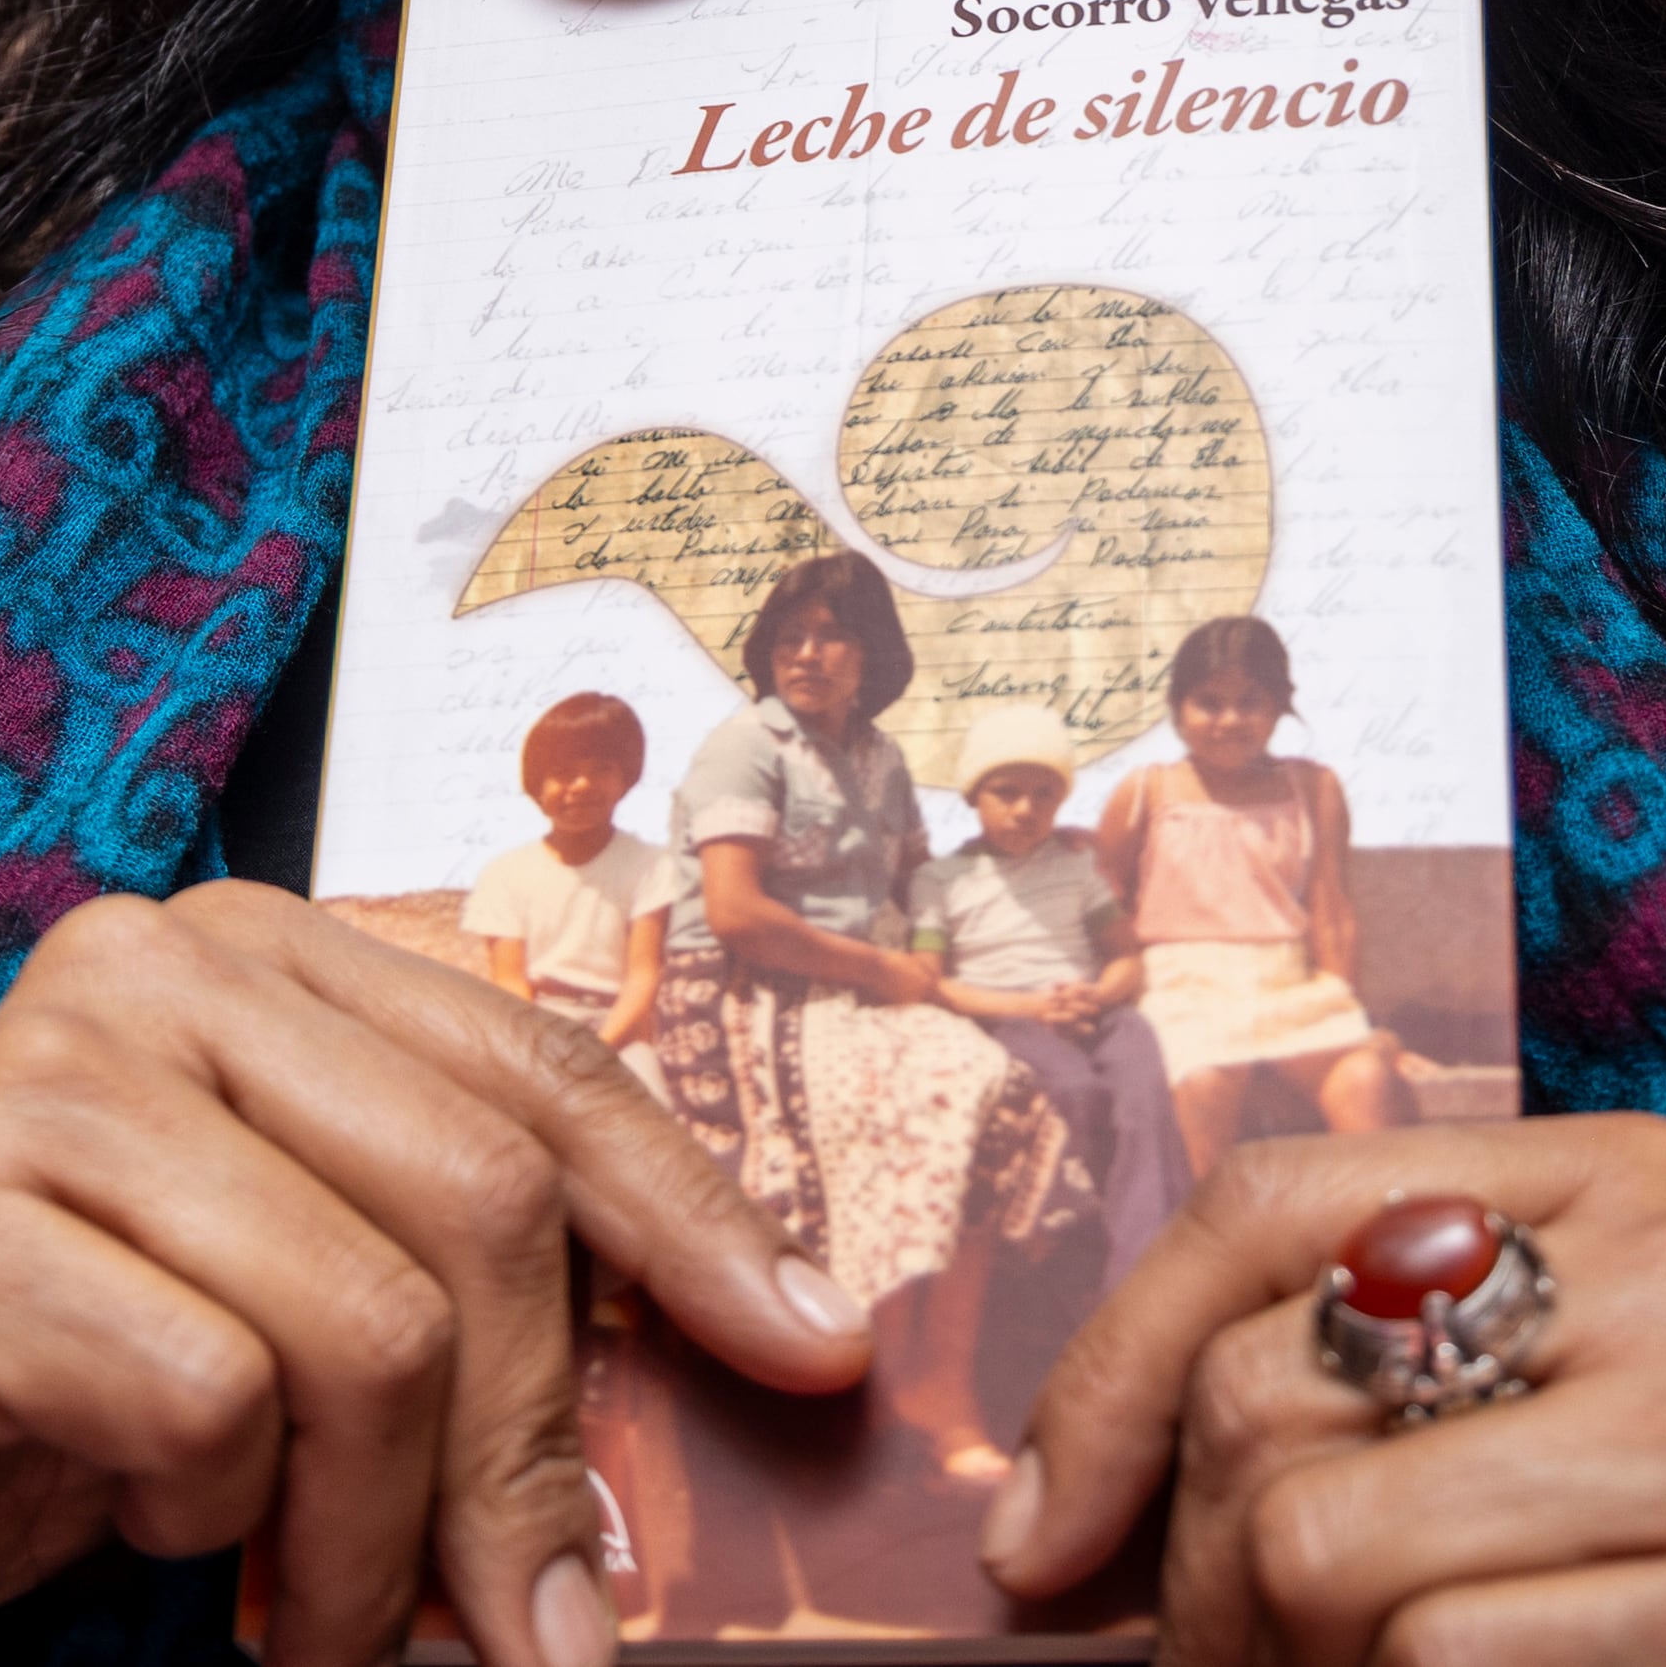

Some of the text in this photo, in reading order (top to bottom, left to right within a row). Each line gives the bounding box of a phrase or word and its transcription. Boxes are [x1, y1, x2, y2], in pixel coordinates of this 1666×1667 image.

[671, 84, 933, 176] Leche
[950, 70, 1060, 151] de
[1073, 56, 1410, 141] silencio
